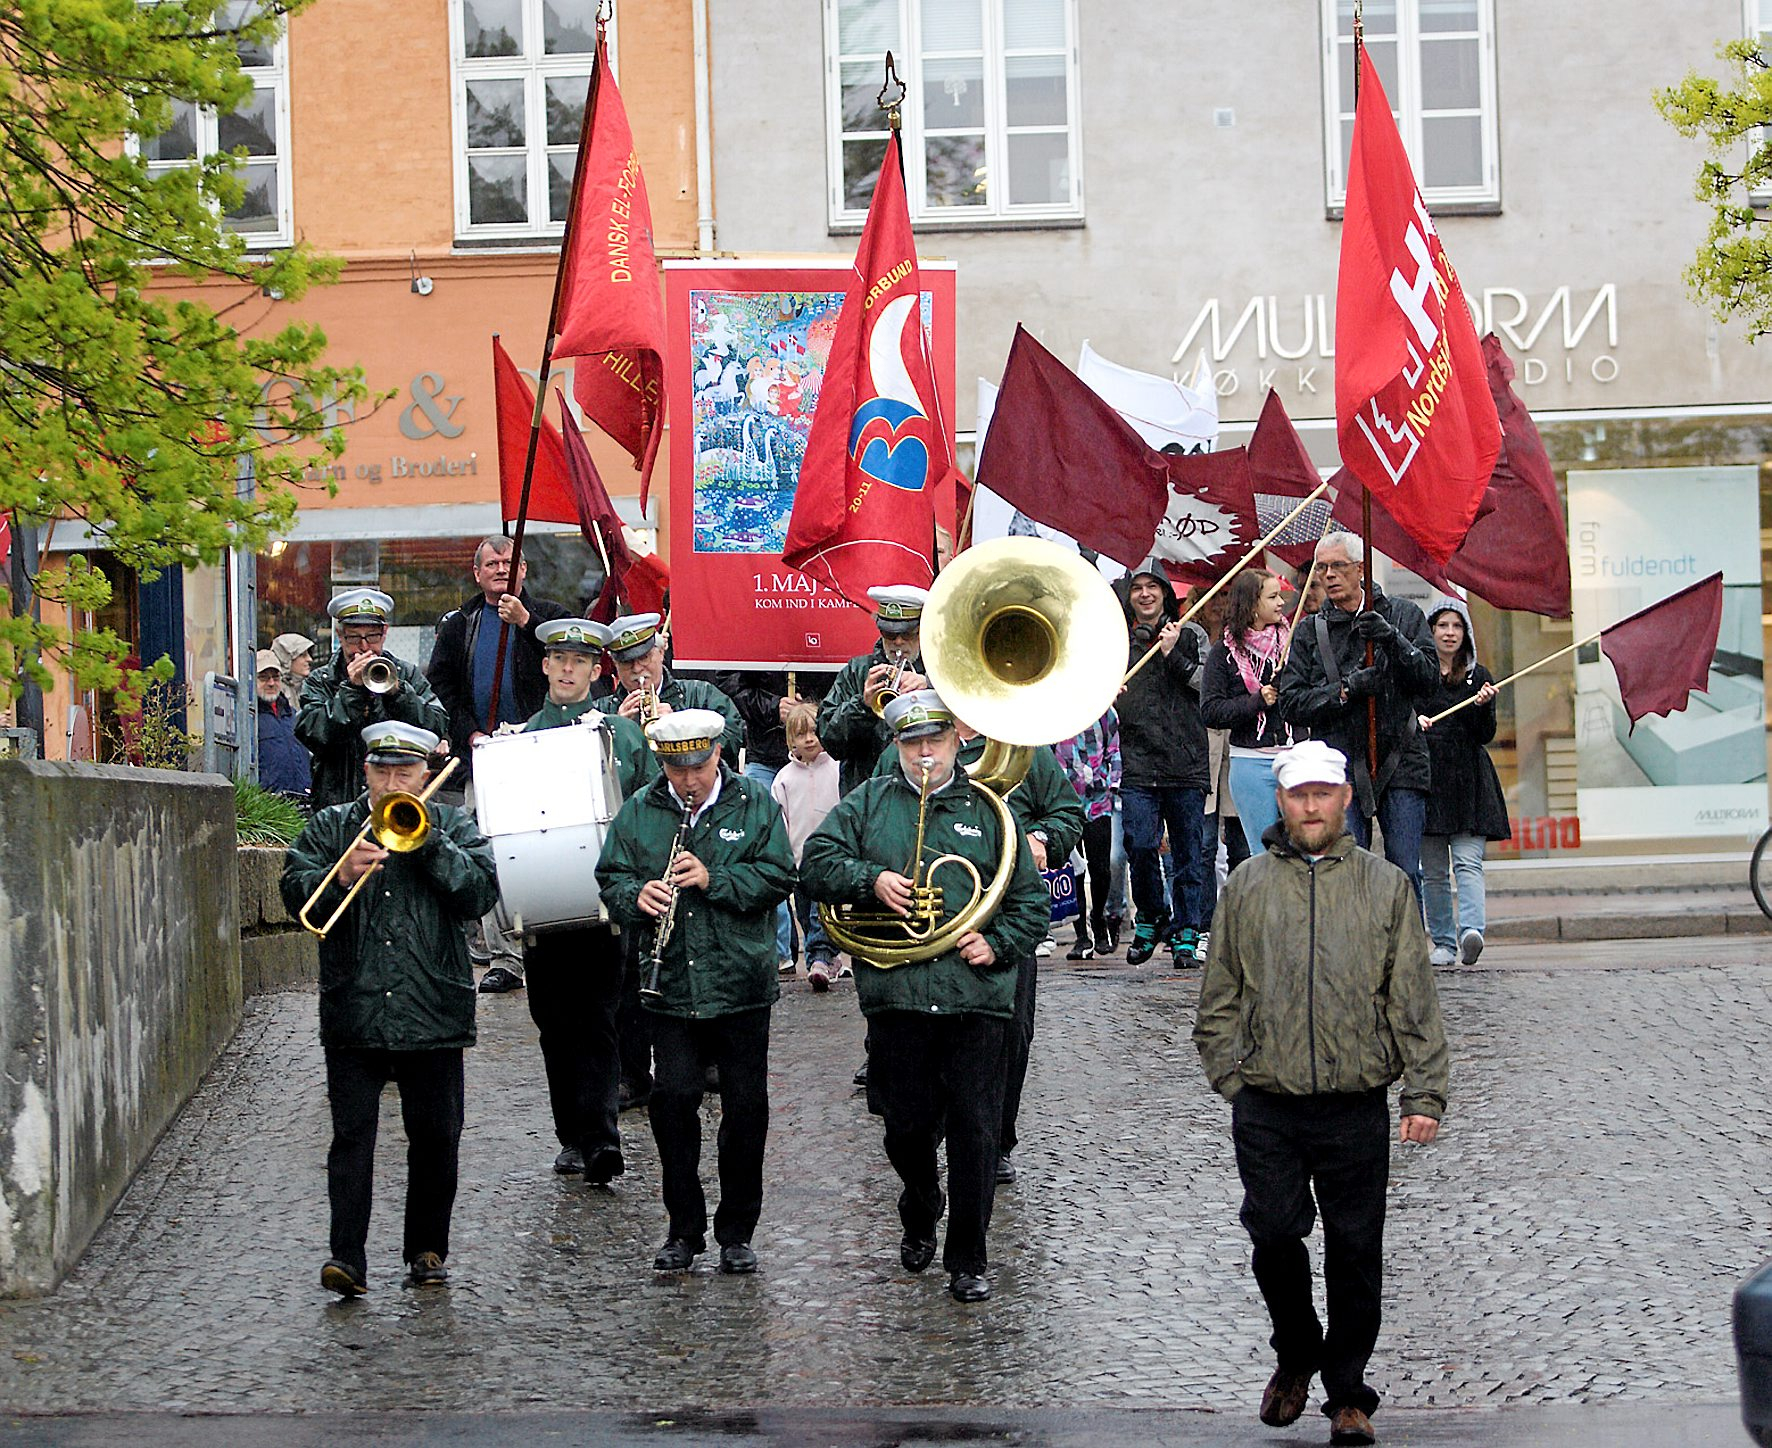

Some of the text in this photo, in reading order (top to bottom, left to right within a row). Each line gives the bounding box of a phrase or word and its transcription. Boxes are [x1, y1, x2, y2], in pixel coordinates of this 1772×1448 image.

[608, 217, 632, 283] DANSK
[864, 259, 913, 309] ORBUND
[602, 351, 658, 405] HILLE
[399, 371, 465, 440] &
[355, 463, 382, 485] og
[391, 451, 478, 478] Broderi
[848, 481, 872, 513] 20-11
[1580, 521, 1600, 576] form
[1601, 554, 1697, 577] fuldendt
[753, 573, 817, 596] 1. MAJ
[755, 598, 782, 609] KOM
[785, 598, 808, 609] IND
[810, 598, 815, 609] I
[657, 738, 708, 753] ARLSBERG
